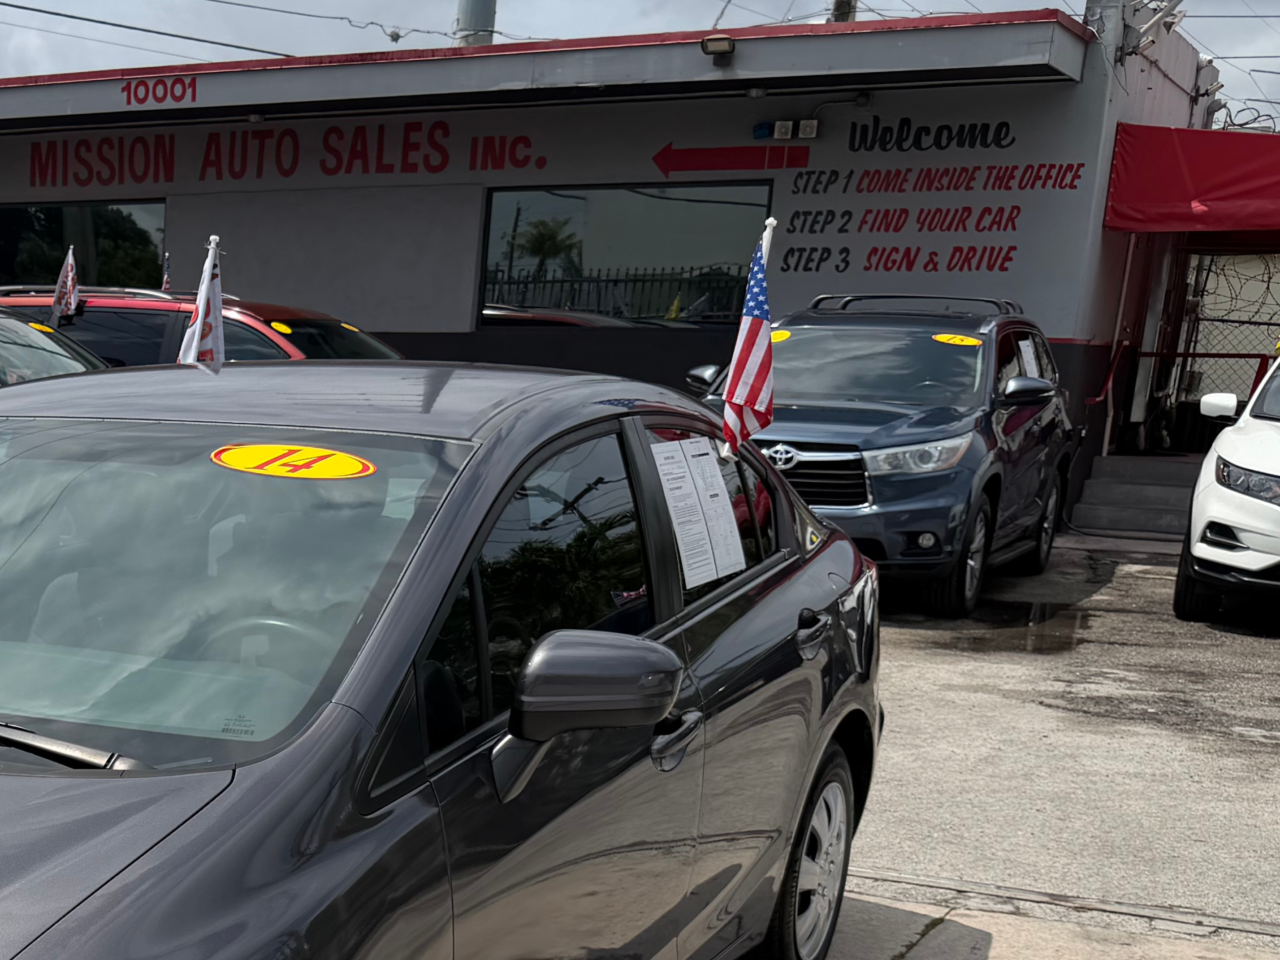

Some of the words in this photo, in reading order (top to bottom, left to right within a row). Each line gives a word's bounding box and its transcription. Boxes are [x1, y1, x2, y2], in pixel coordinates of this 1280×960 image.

[121, 77, 197, 106] 10001
[848, 114, 1016, 153] Welcome
[29, 134, 175, 188] MISSION
[198, 128, 300, 182] AUTO
[320, 120, 450, 177] SALES
[469, 135, 548, 171] INC.
[792, 169, 839, 195] STEP
[843, 169, 854, 193] 1
[856, 168, 912, 194] COME
[913, 166, 981, 193] INSIDE
[985, 164, 1016, 191] THE
[1018, 162, 1085, 190] OFFICE
[786, 209, 837, 235] STEP
[838, 209, 853, 233] 2
[857, 207, 908, 233] FIND
[916, 205, 971, 233] YOUR
[974, 204, 1021, 232] CAR
[780, 247, 833, 273] STEP
[835, 246, 851, 273] 3
[863, 246, 918, 272] SIGN
[922, 250, 939, 272] &
[946, 245, 1018, 272] DRIVE
[244, 449, 337, 474] 14
